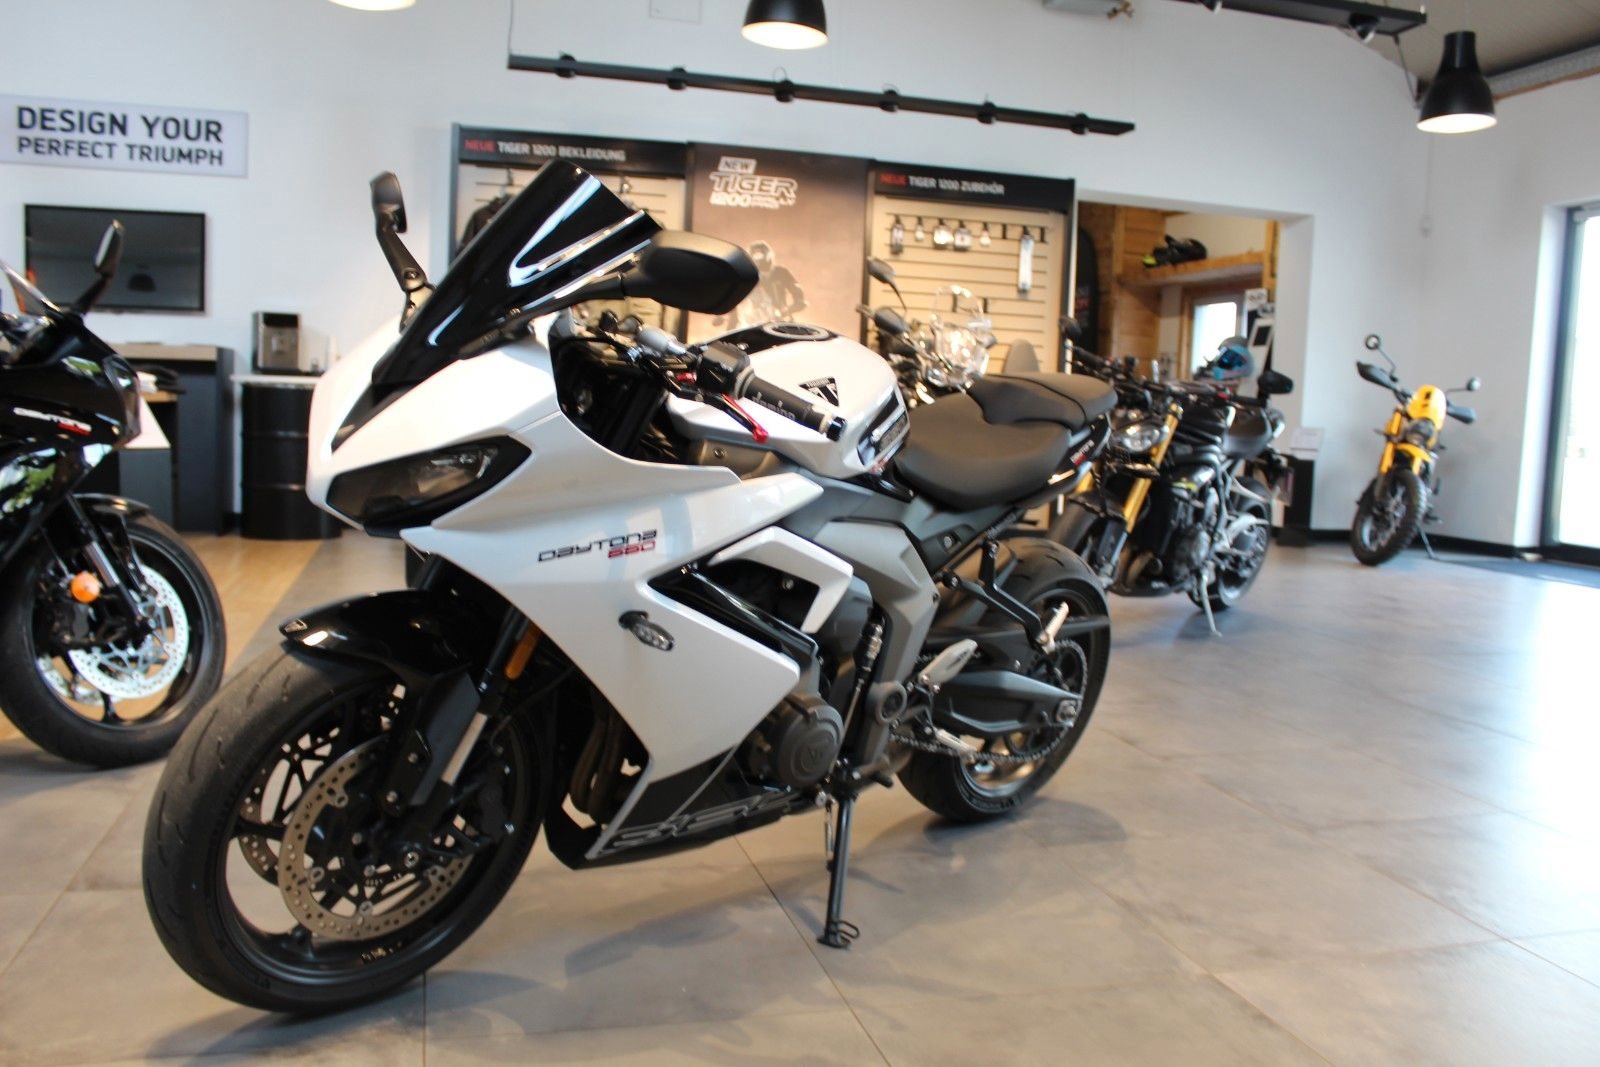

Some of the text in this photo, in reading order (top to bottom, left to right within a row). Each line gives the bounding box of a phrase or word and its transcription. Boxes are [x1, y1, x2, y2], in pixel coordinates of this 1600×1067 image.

[17, 106, 223, 143] DESIGN YOUR
[17, 136, 224, 166] PERFECT TRIUMPH
[464, 139, 626, 161] NEUE TIGER 1200 BEKLEIDUNG
[723, 159, 751, 170] NEW
[709, 172, 798, 199] TIGER
[908, 175, 937, 189] TIGER
